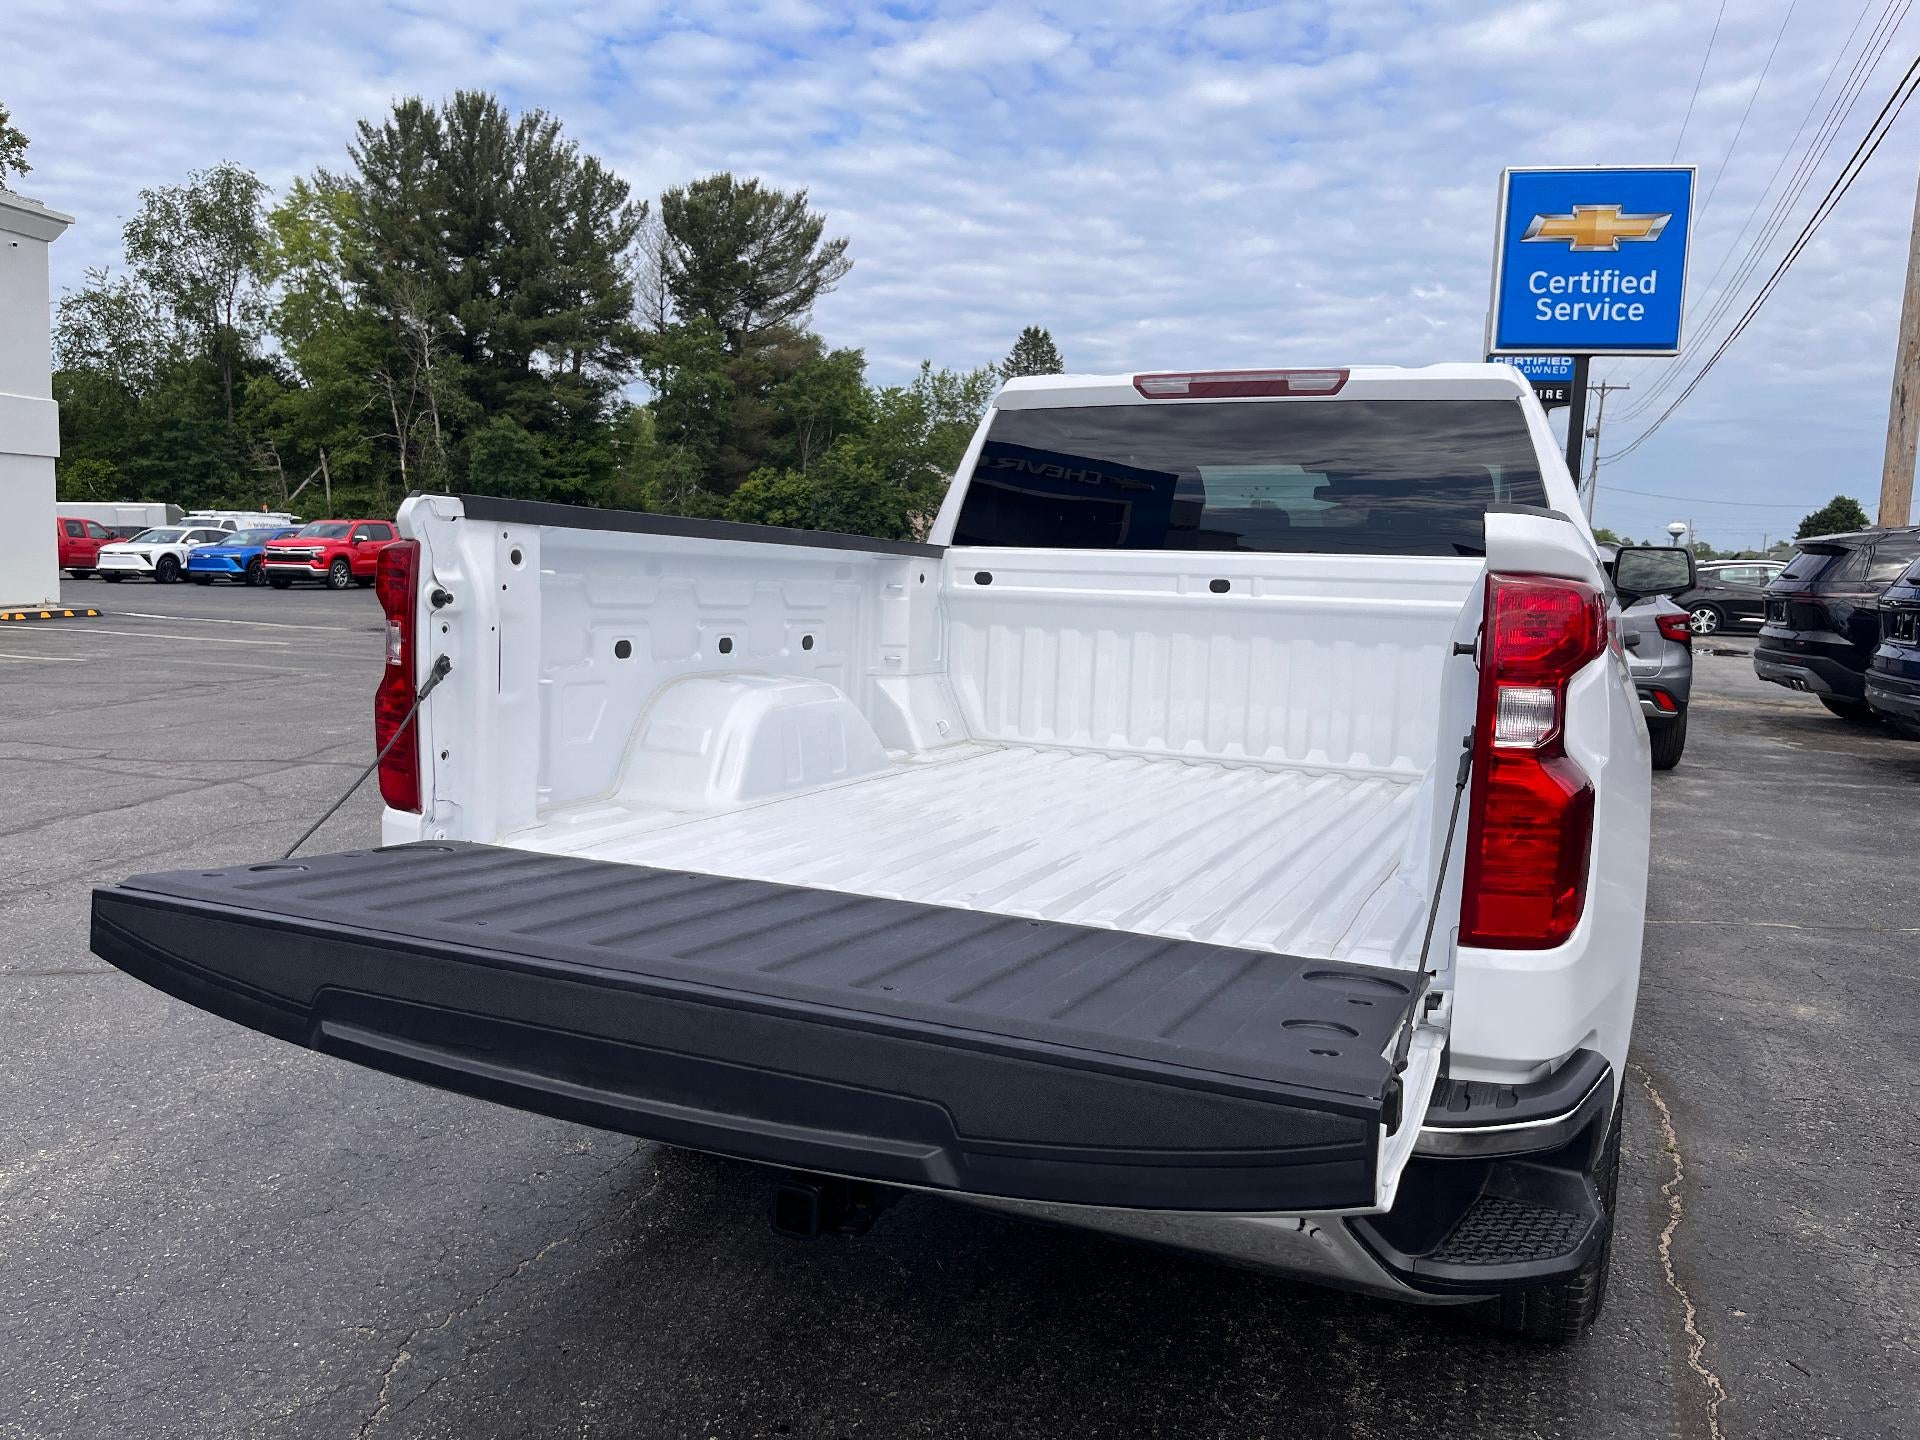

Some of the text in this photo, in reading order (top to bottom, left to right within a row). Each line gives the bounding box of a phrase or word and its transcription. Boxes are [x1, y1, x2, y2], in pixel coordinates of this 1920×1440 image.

[1529, 270, 1657, 294] Certified
[1536, 298, 1644, 321] Service
[1493, 356, 1572, 365] CERTIFIED
